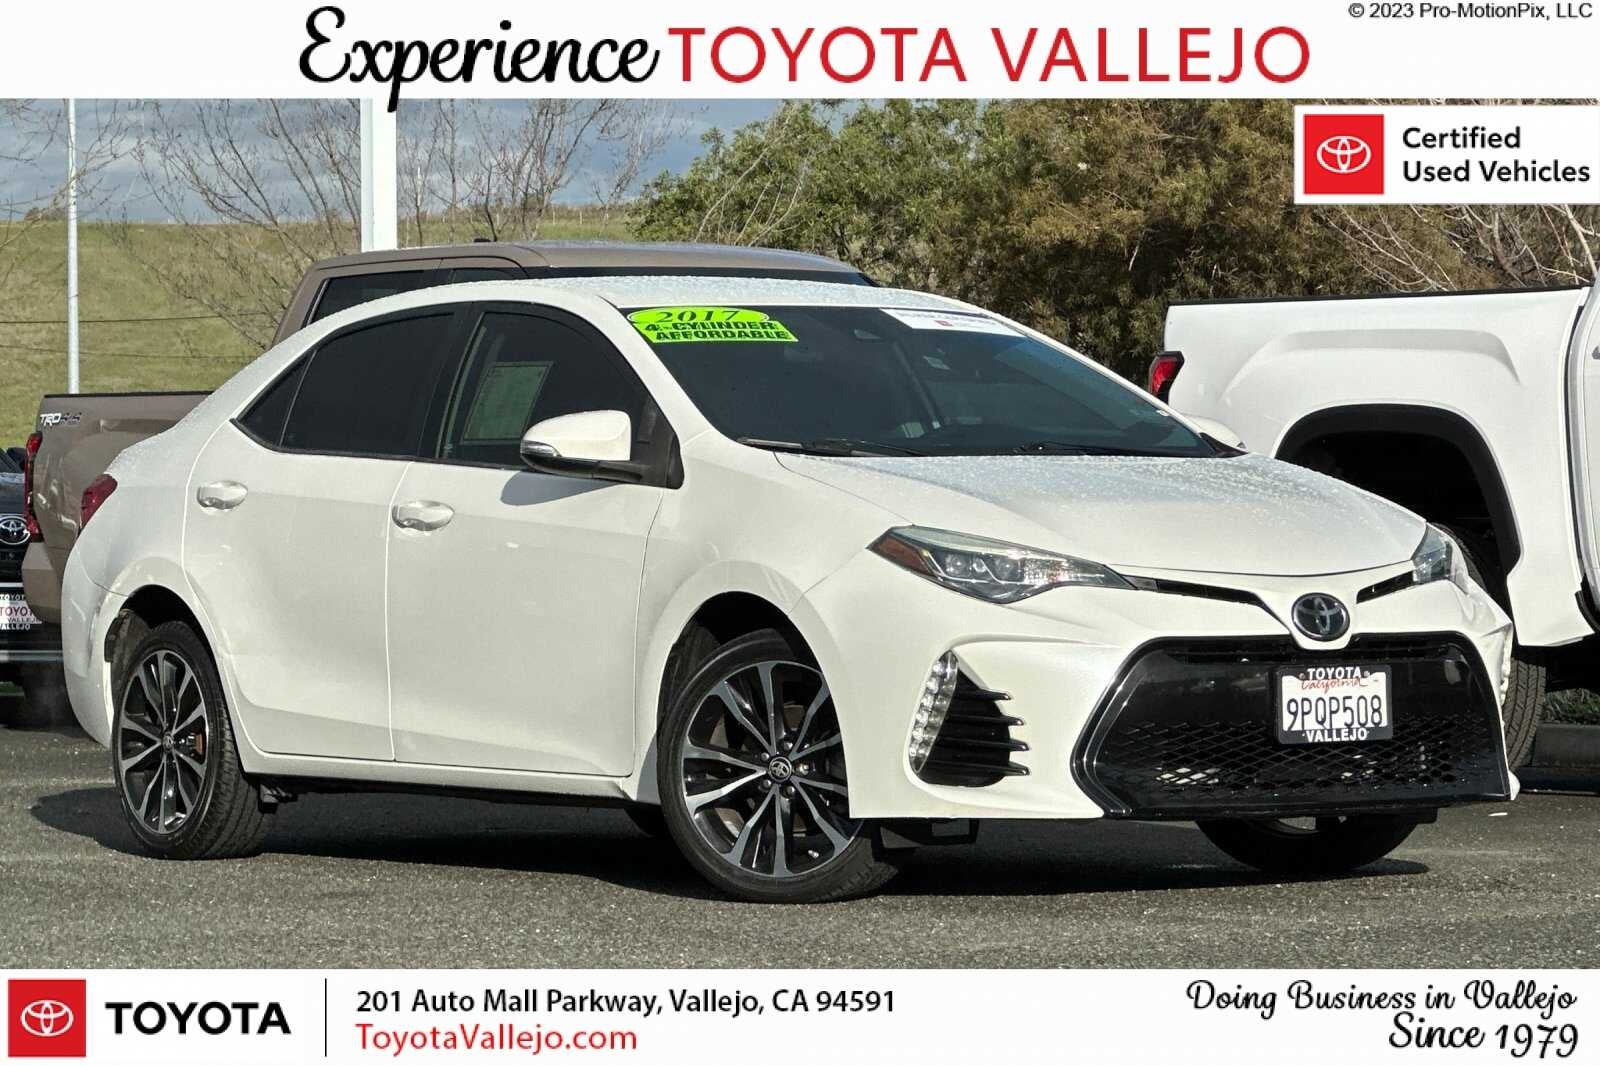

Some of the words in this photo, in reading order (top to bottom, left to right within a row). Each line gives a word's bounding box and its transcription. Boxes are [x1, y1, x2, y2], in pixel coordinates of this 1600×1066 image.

[656, 310, 739, 323] 2017
[655, 330, 786, 340] AFFORDABLE
[1307, 666, 1362, 680] TOYOTA
[1287, 694, 1382, 731] 9PQP508
[1306, 728, 1368, 742] VALLEJO
